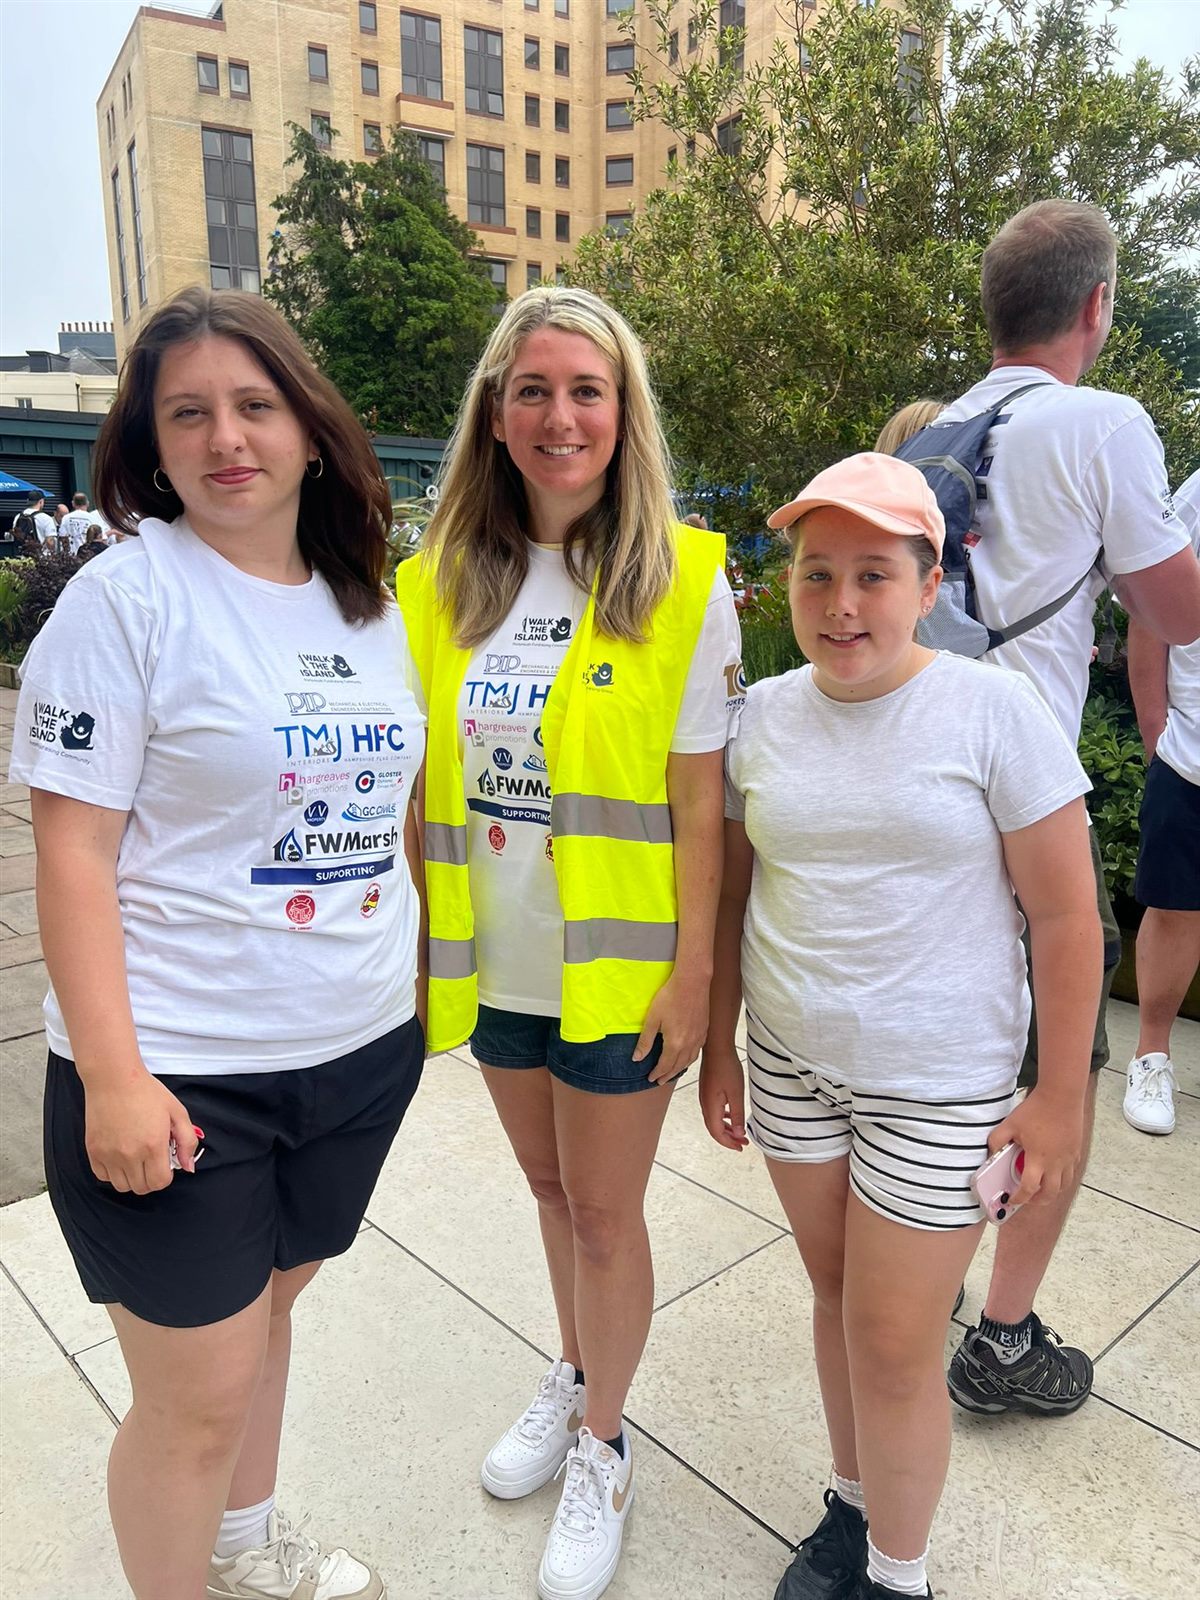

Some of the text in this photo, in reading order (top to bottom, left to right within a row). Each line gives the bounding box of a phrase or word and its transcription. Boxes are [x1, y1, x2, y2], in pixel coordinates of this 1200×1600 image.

[528, 617, 555, 626] WALK
[530, 625, 548, 634] THE
[514, 633, 549, 642] ISLAND
[302, 653, 331, 664] WALK
[309, 661, 330, 671] THE
[300, 669, 336, 679] ISLAND
[466, 681, 520, 715] TMJ
[38, 702, 71, 721] WALK
[478, 722, 527, 734] hargreaves
[29, 725, 56, 743] ISLND
[485, 733, 527, 743] promotions
[273, 723, 405, 763] TMJ HFC
[286, 757, 330, 768] INTERIORS
[299, 771, 350, 787] hargreaves
[378, 771, 402, 779] GLOSTER
[306, 783, 349, 798] promotions
[496, 775, 552, 799] FWMa
[315, 865, 375, 881] SUPPORTING
